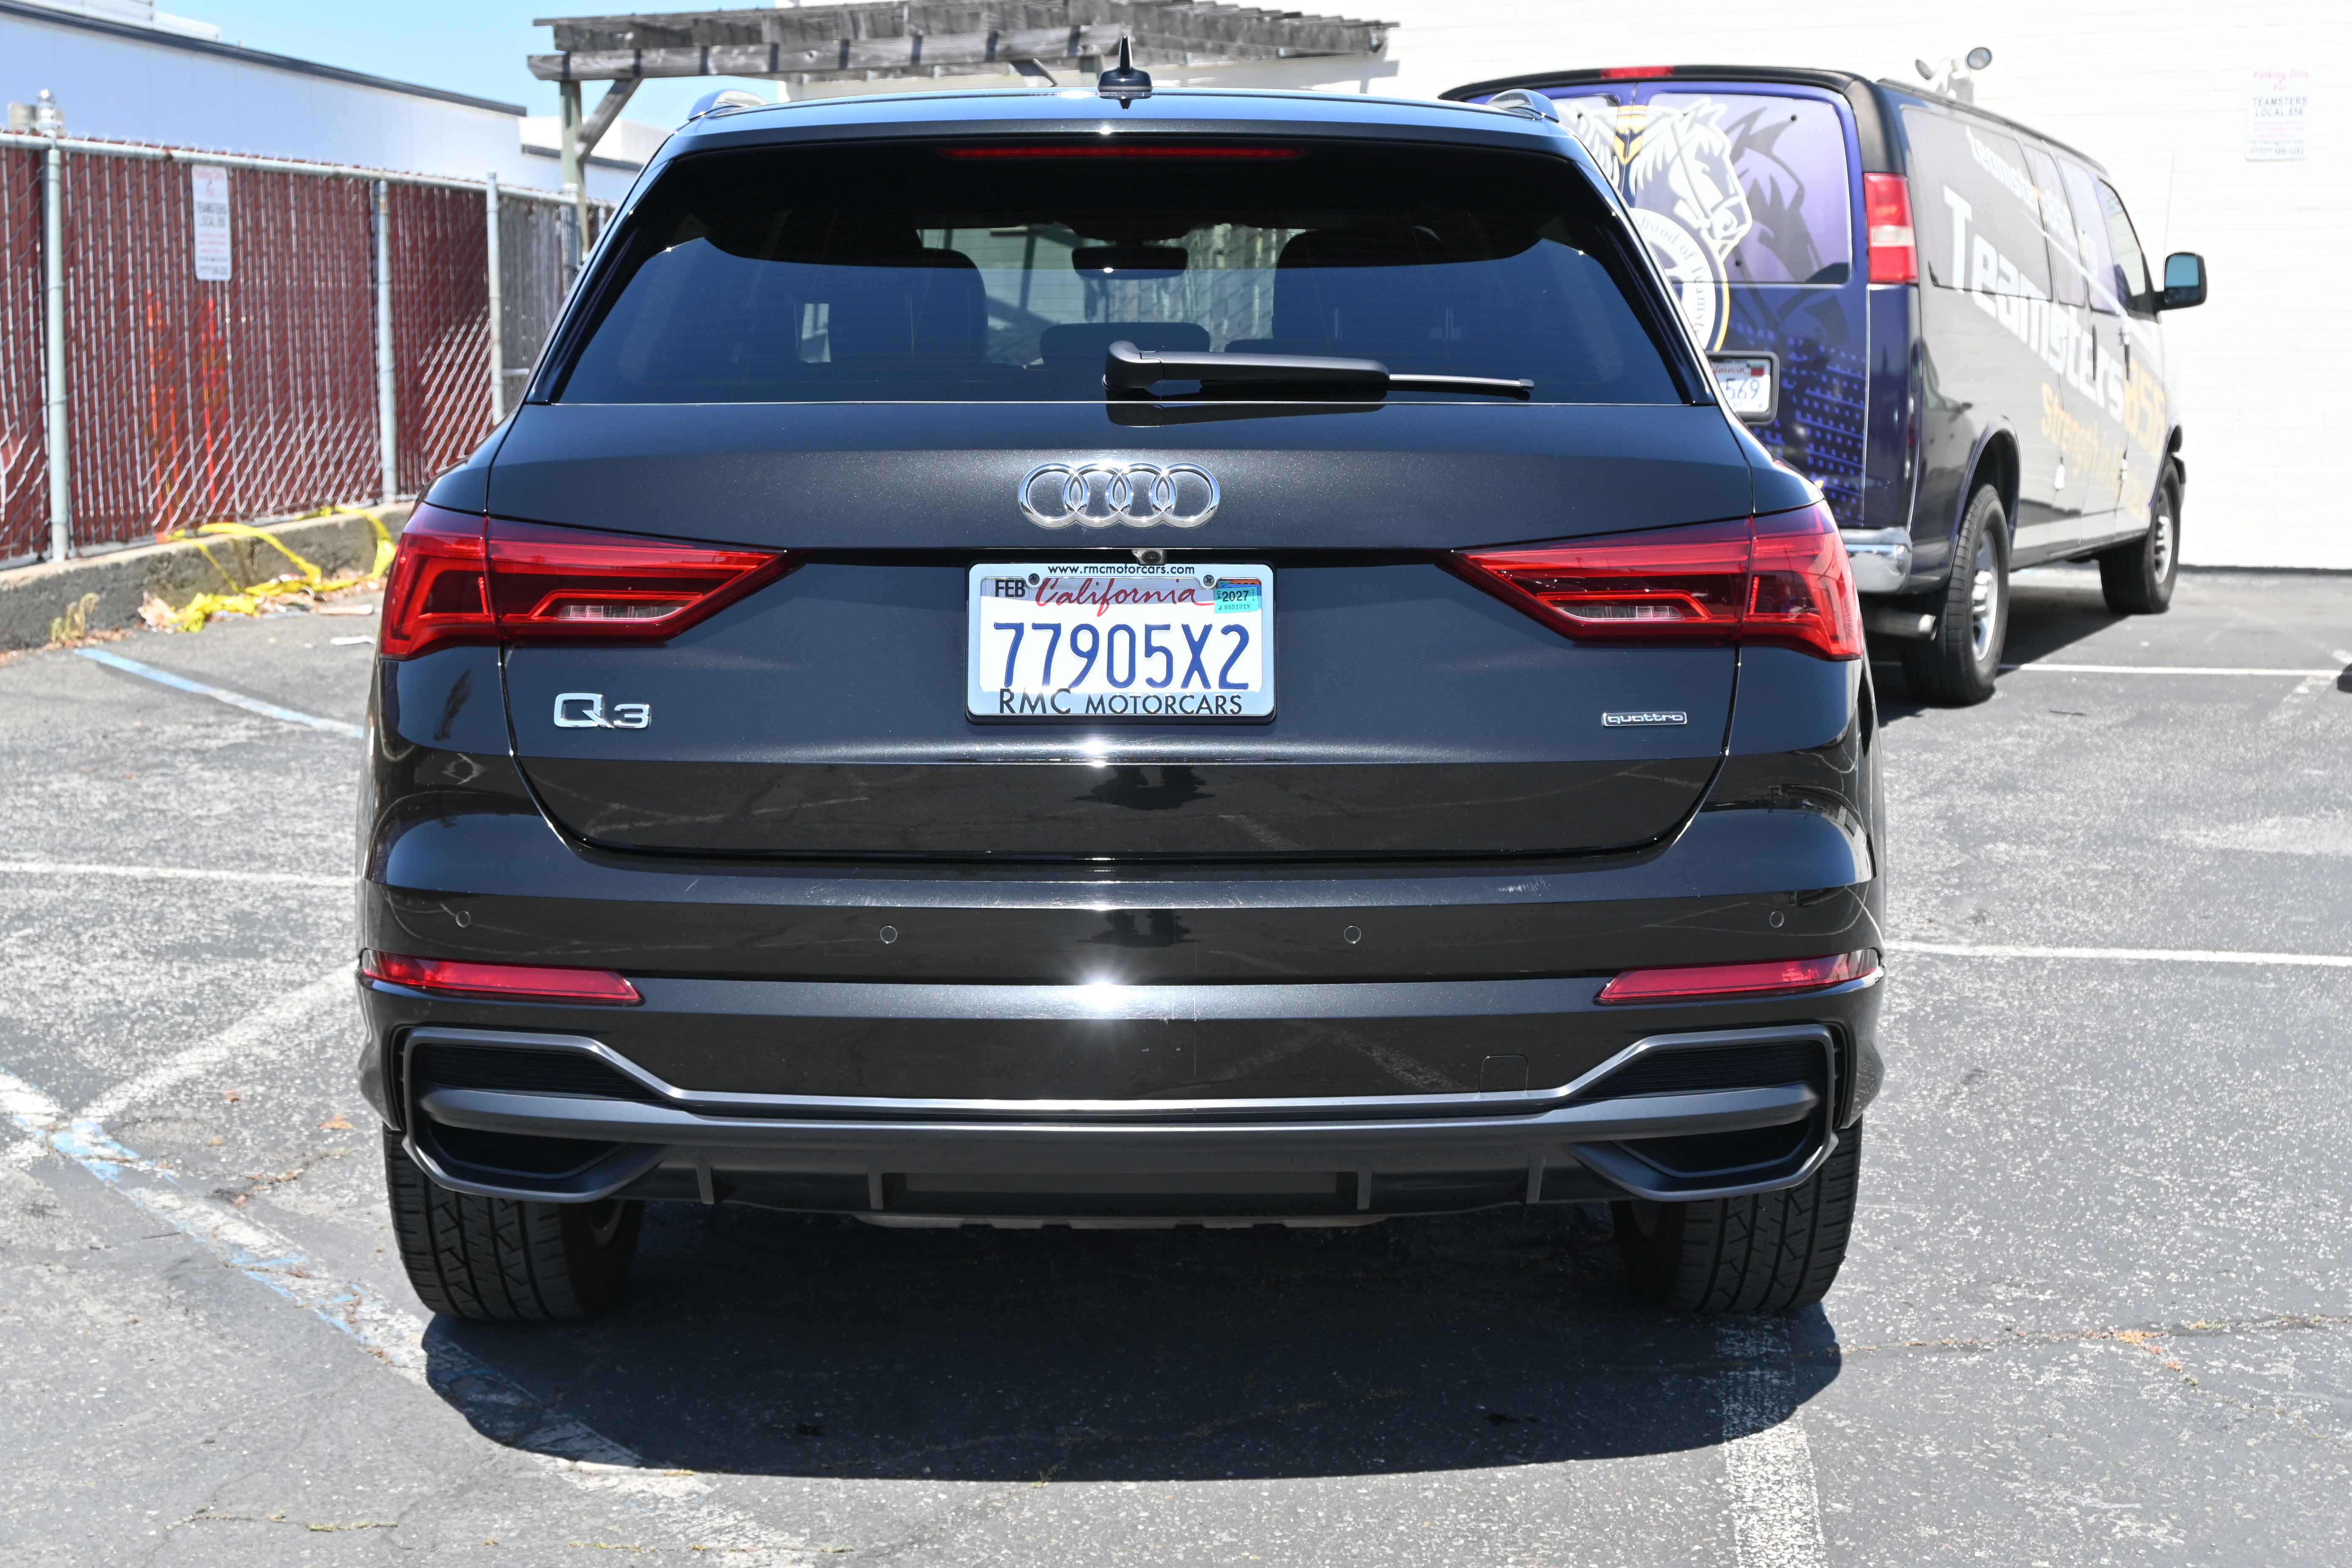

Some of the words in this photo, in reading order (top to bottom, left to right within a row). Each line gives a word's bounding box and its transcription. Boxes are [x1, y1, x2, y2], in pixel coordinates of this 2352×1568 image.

[2254, 70, 2286, 80] Parking
[2289, 69, 2309, 79] Only
[2253, 96, 2307, 106] TEAMSTERS
[2256, 107, 2285, 117] LOCAL
[1680, 245, 1697, 261] of
[1943, 185, 2124, 422] Teamsters
[1048, 564, 1195, 574] www.rmcmotorcars.com
[995, 580, 1026, 597] FEB
[1222, 590, 1249, 602] 2027
[1035, 578, 1214, 617] California
[994, 622, 1250, 689] 77905X2
[999, 688, 1071, 715] RMC
[1085, 693, 1242, 715] MOTORCARS
[553, 693, 651, 729] Q3
[1607, 713, 1684, 724] quattro
